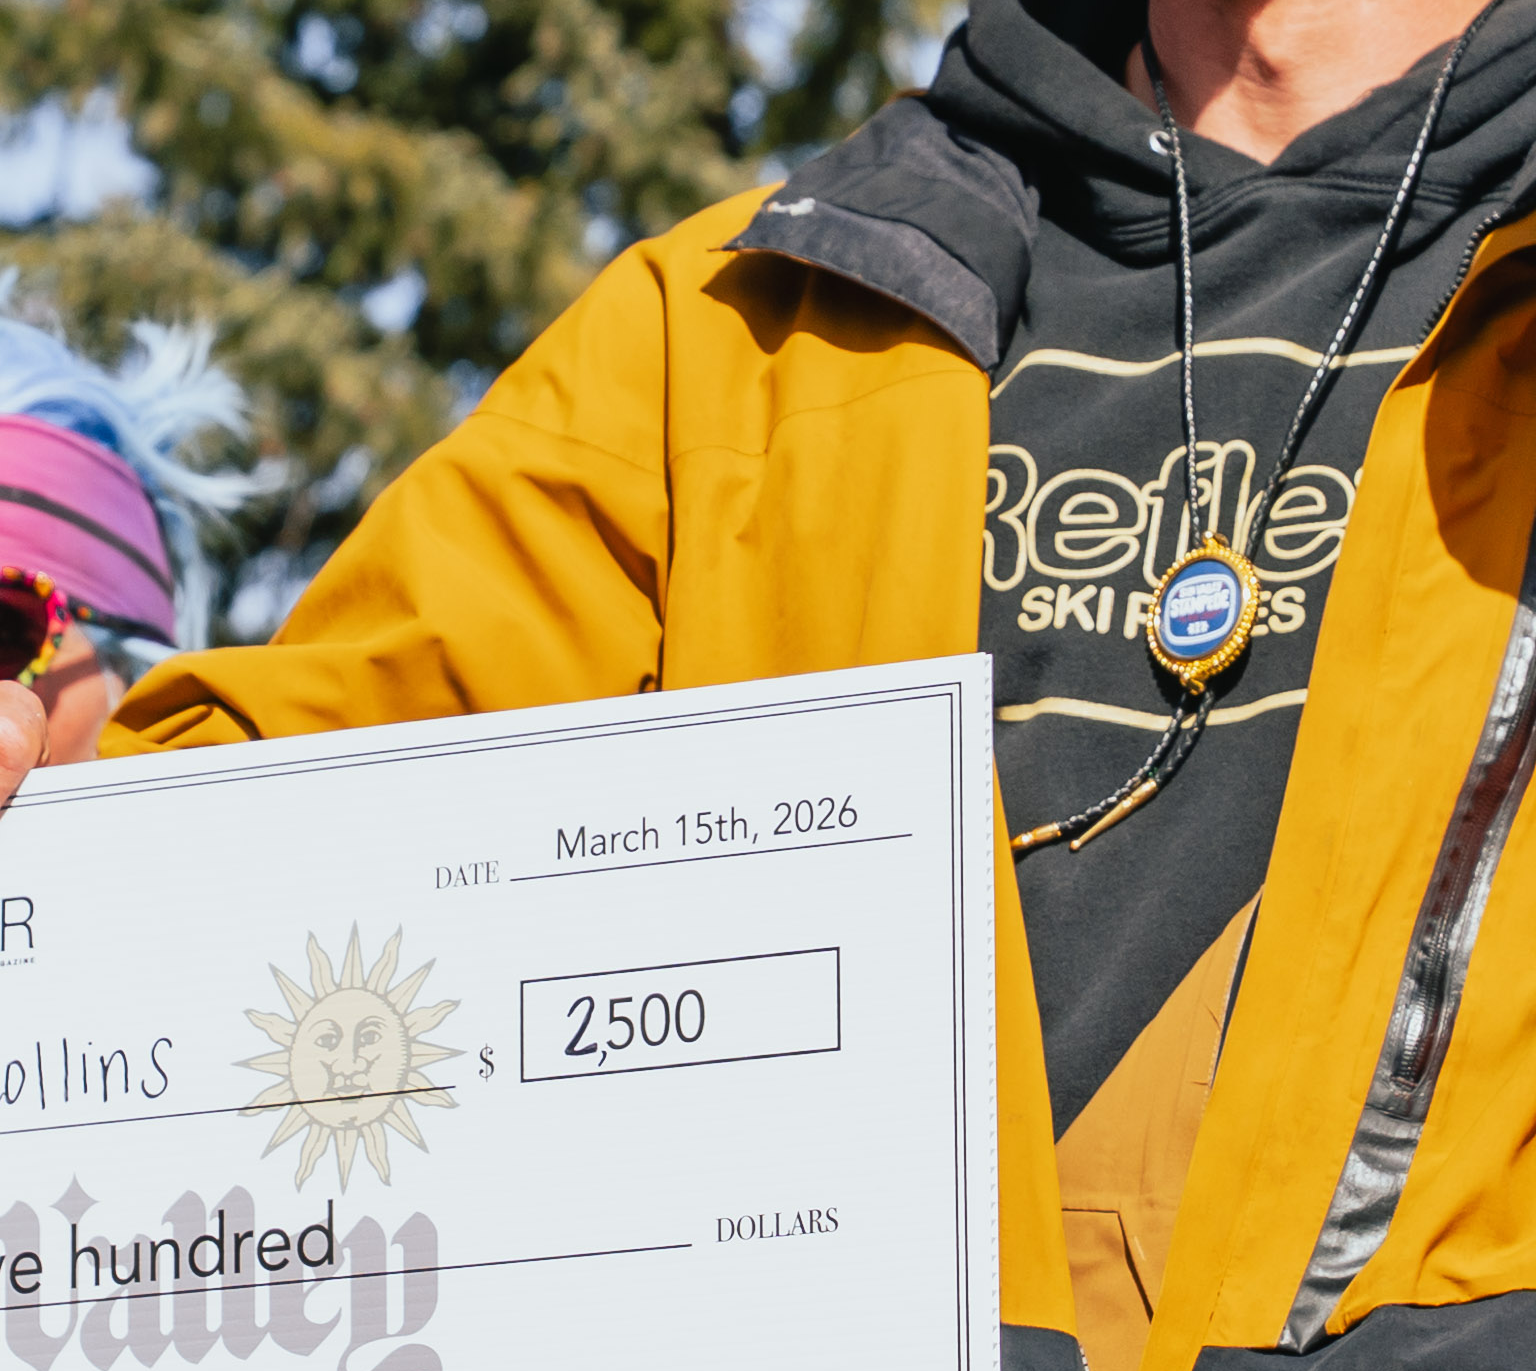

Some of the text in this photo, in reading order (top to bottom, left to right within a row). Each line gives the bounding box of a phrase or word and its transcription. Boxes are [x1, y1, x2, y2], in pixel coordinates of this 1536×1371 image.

[983, 441, 1364, 591] Refle
[1017, 585, 1115, 634] SKI
[436, 794, 858, 890] DATE March 15th, 2026
[478, 989, 706, 1083] $ 2,500
[71, 1199, 334, 1289] hundred
[716, 1207, 839, 1243] DOLLARS
